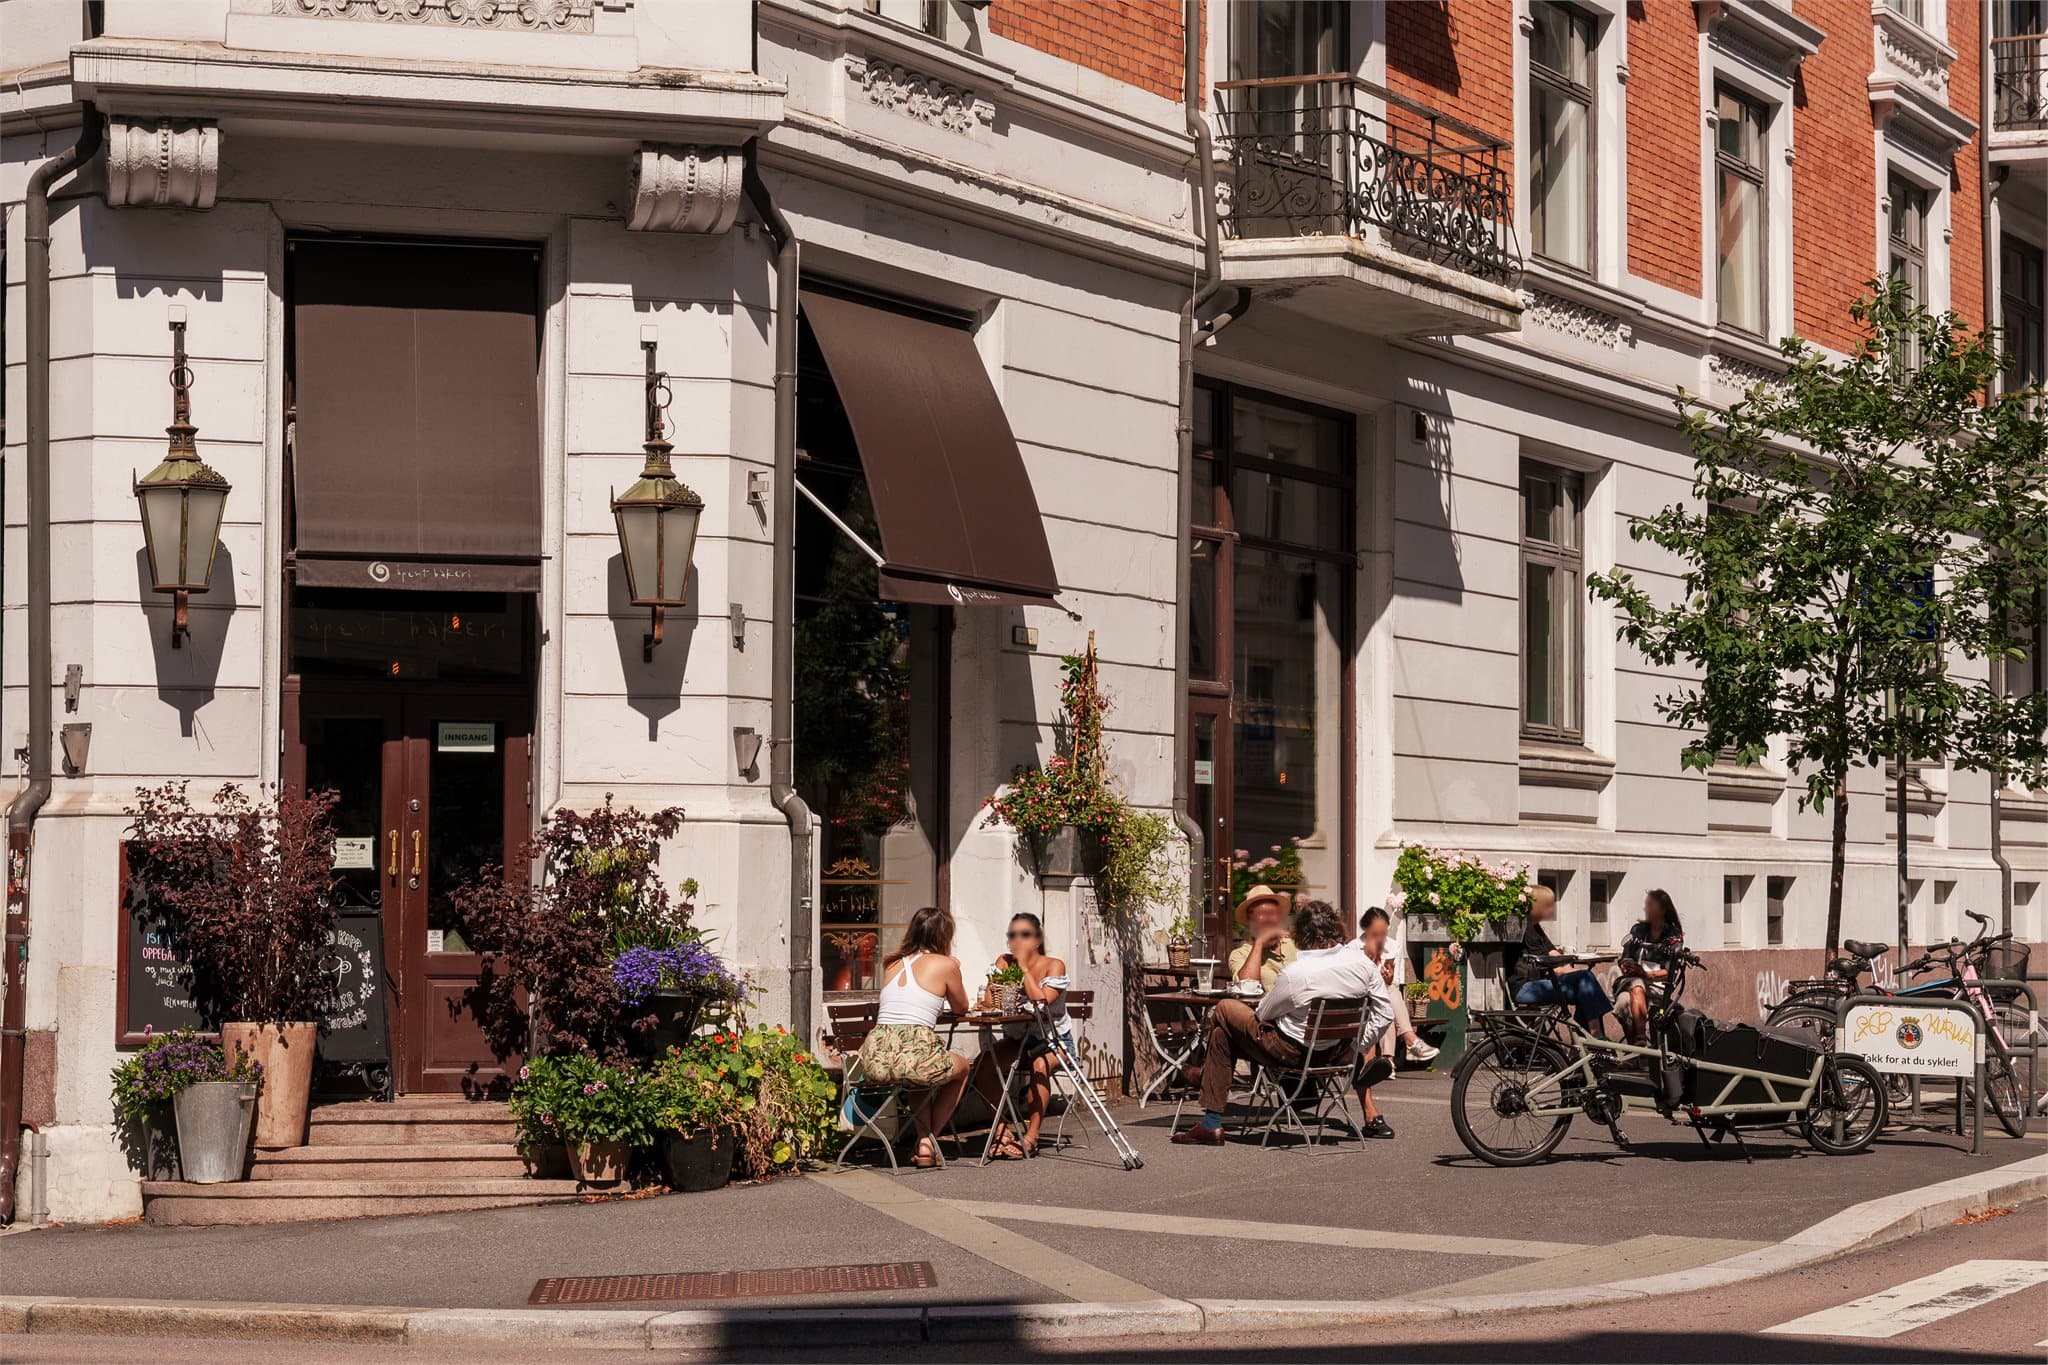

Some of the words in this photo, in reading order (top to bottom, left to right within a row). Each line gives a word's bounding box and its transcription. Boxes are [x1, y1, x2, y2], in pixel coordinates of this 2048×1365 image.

[397, 564, 430, 583] åpent
[433, 567, 471, 580] bakeri
[444, 733, 488, 742] INNGANG
[337, 929, 362, 953] KOPP
[144, 965, 157, 979] og
[159, 966, 177, 980] mye
[155, 974, 176, 988] juice
[1862, 1053, 1884, 1064] Takk
[1885, 1054, 1899, 1065] for
[1901, 1056, 1911, 1065] at
[1912, 1055, 1925, 1066] du
[1927, 1056, 1959, 1068] sykler!
